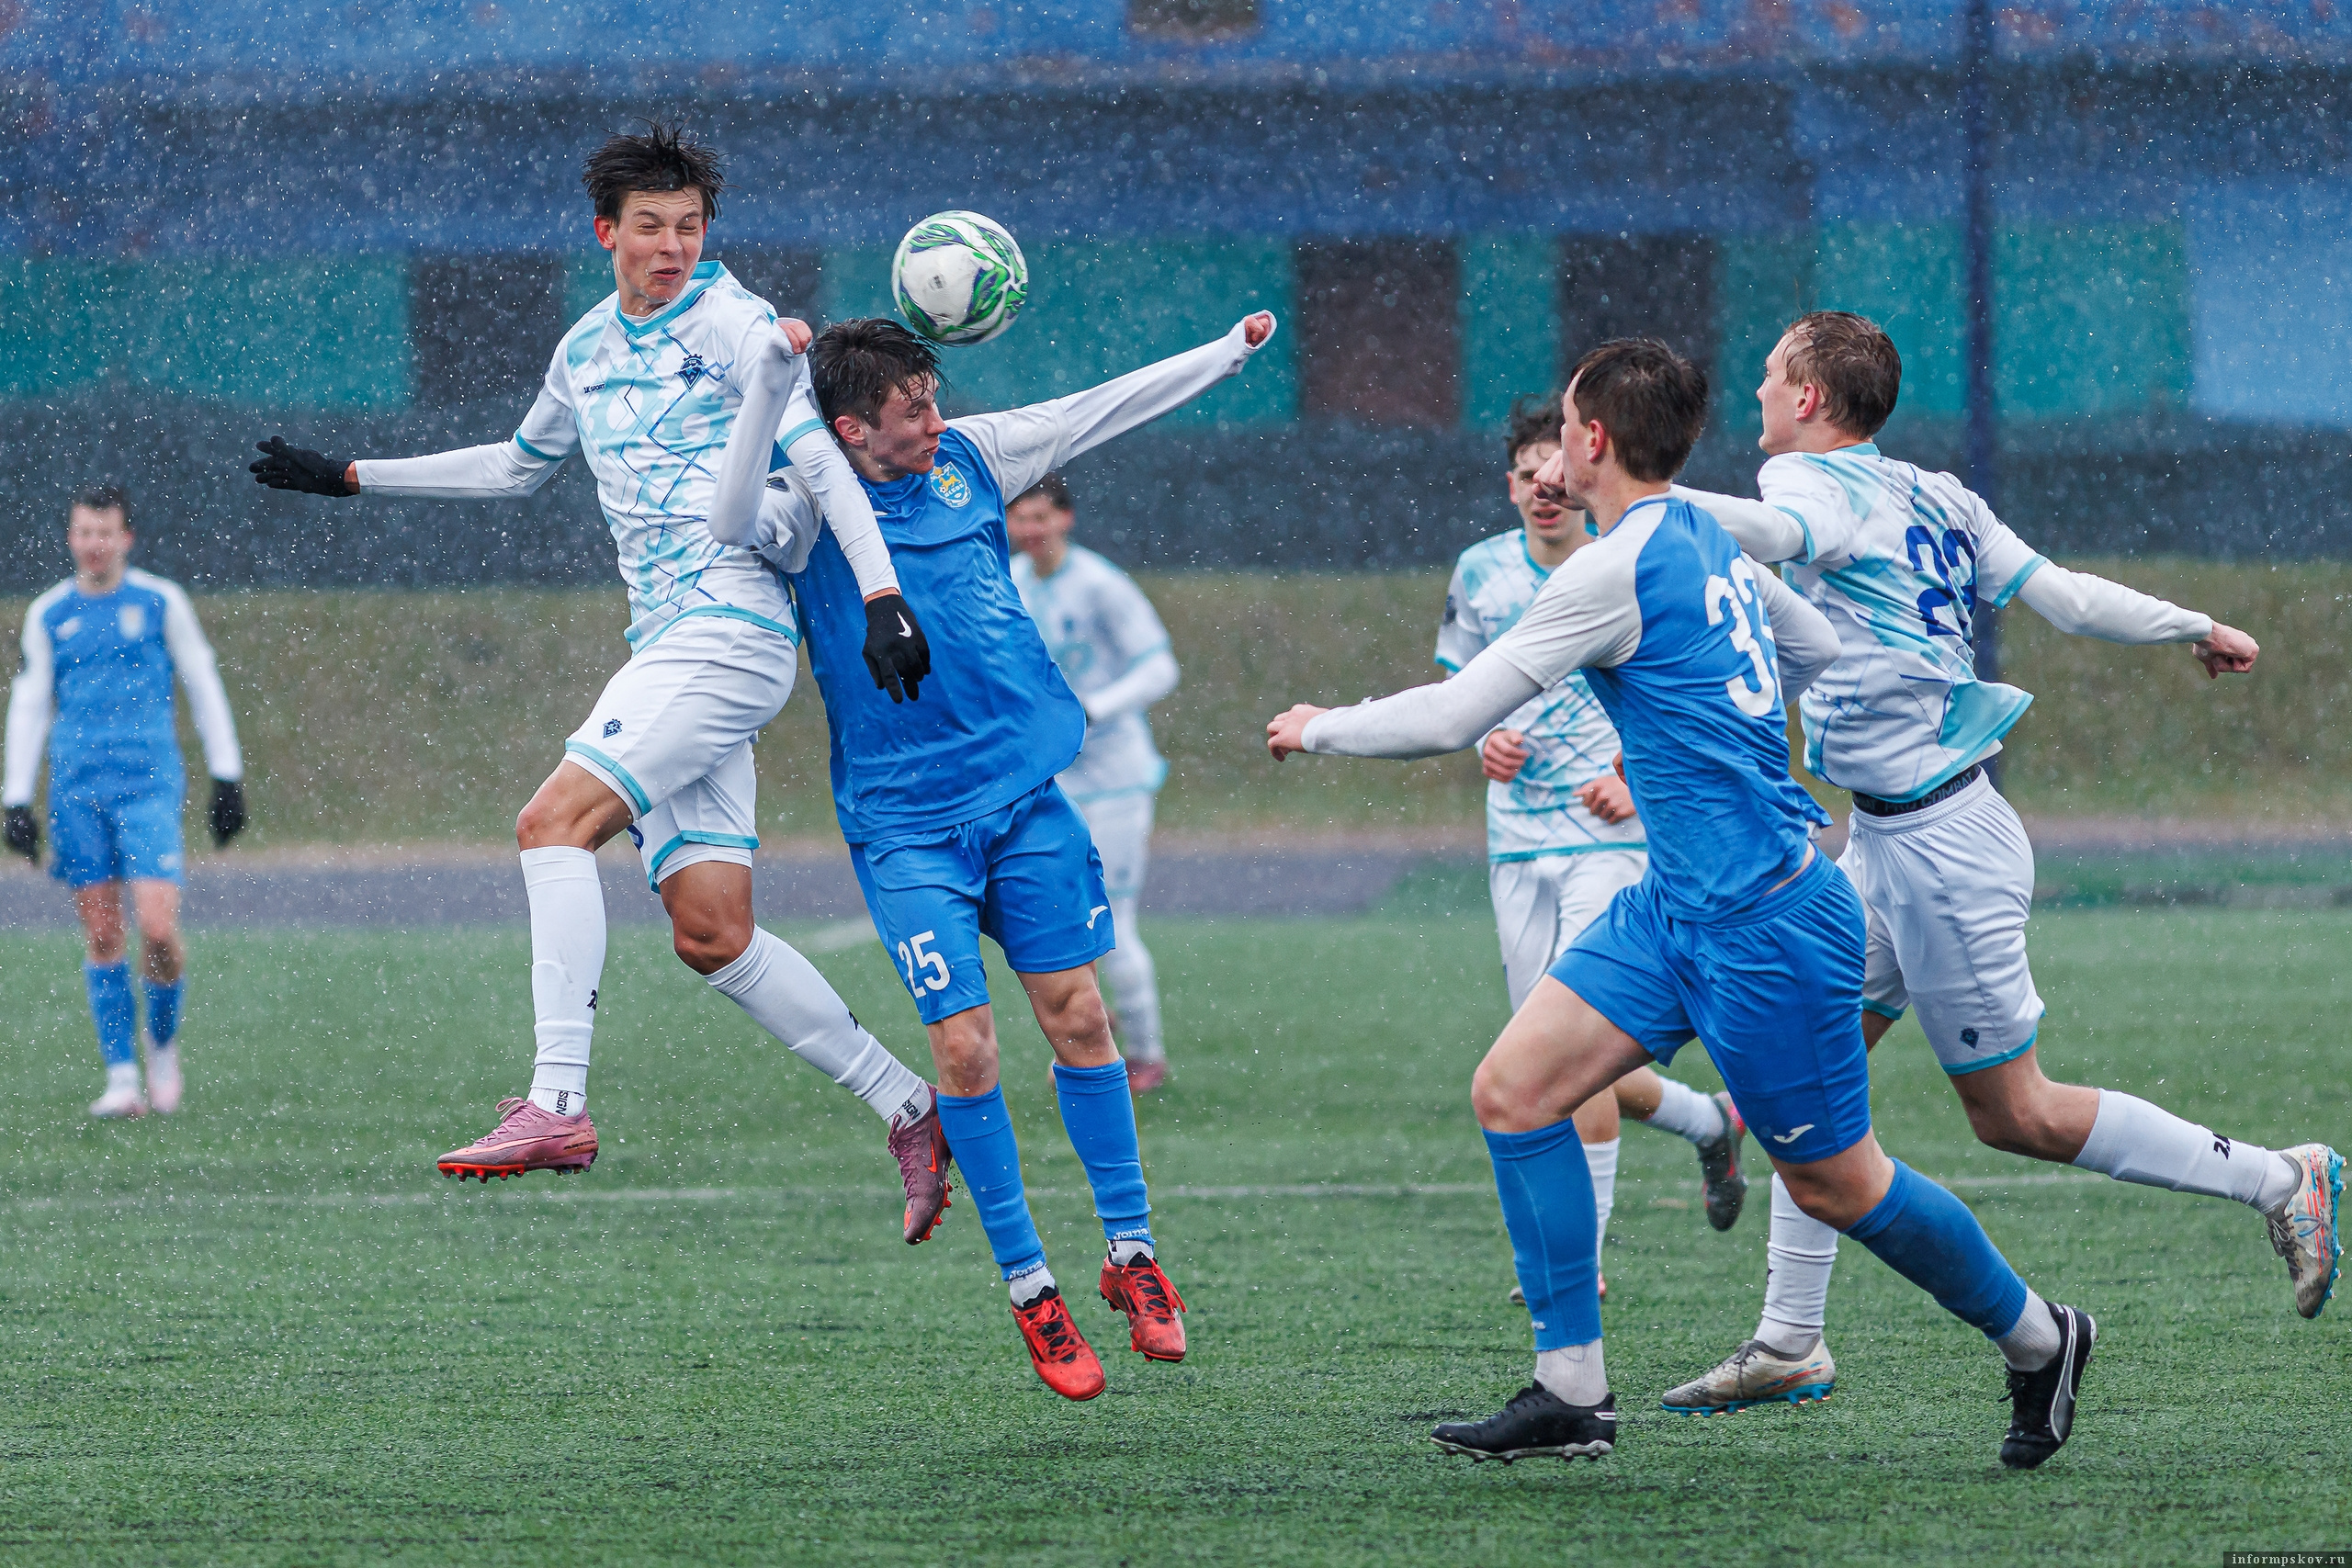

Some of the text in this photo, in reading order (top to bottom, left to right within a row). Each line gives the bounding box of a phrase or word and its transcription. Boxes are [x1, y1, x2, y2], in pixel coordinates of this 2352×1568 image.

[591, 383, 605, 392] SPORT
[1921, 772, 1973, 807] COMBAT
[898, 930, 950, 998] 25
